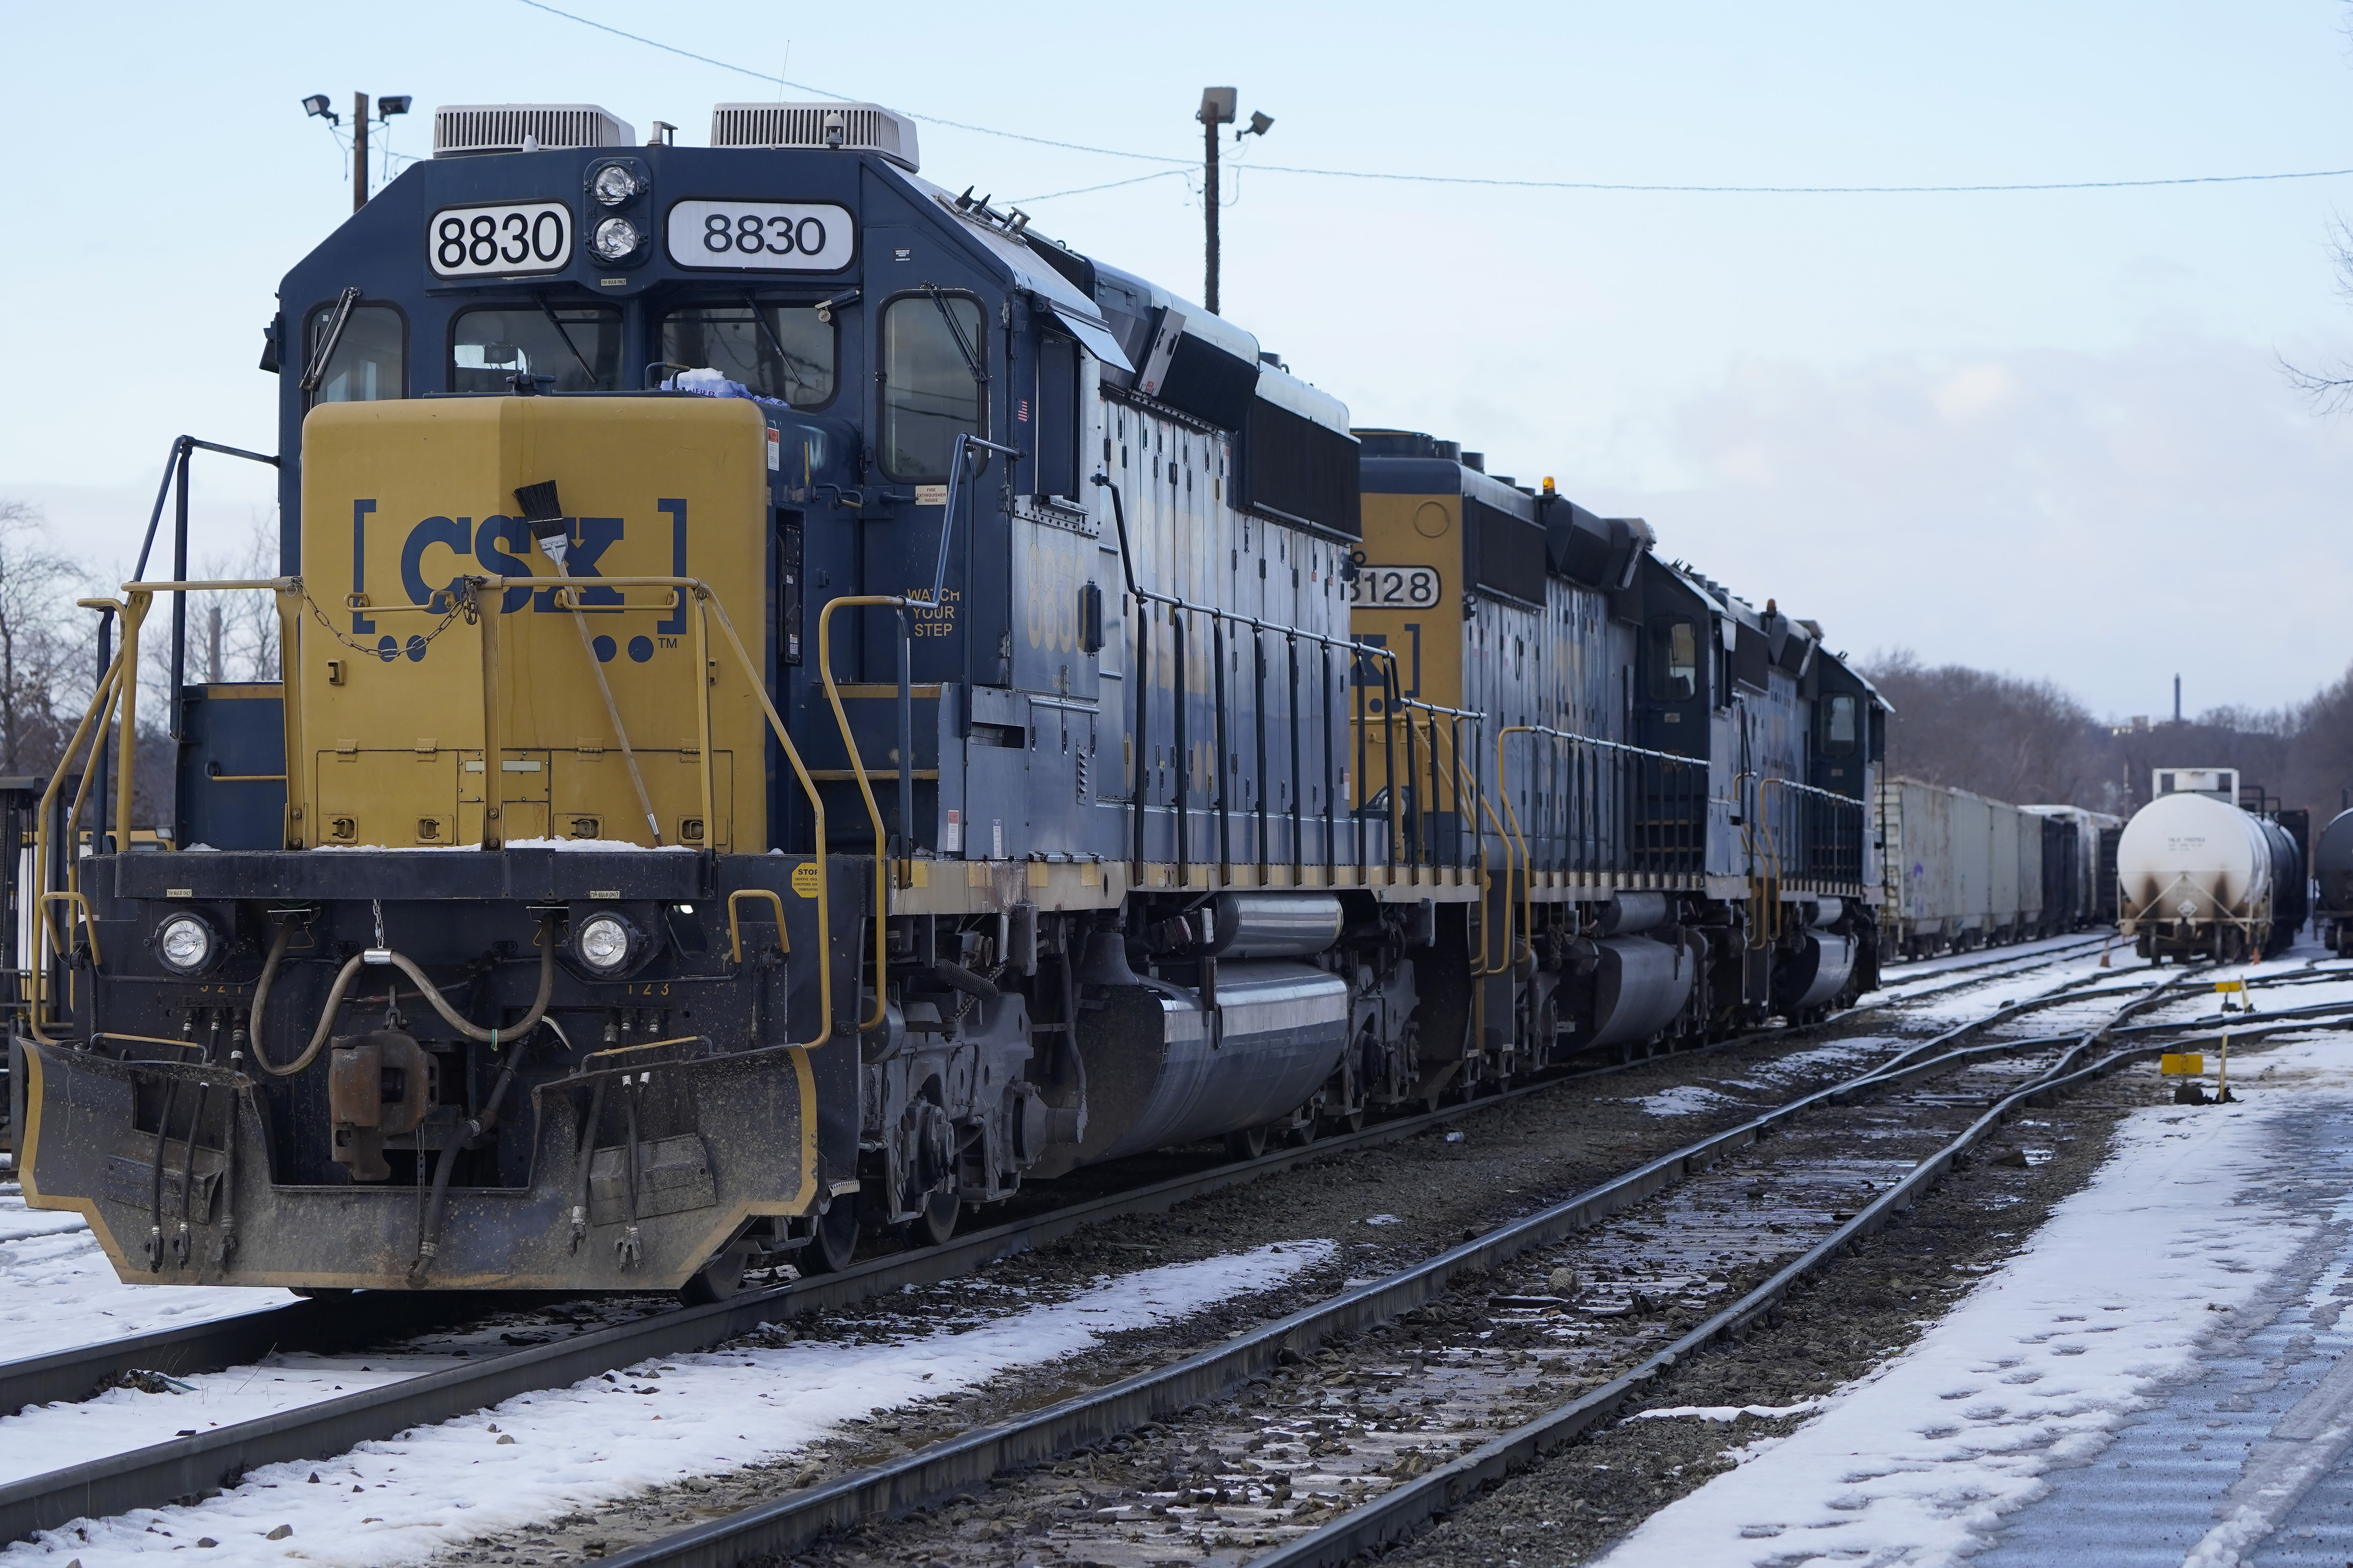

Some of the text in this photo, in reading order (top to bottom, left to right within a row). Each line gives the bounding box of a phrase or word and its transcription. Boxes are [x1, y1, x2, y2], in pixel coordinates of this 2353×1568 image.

[438, 211, 563, 268] 8830
[704, 214, 826, 255] 8830
[401, 514, 625, 615] CSX
[907, 588, 960, 601] WACH
[913, 606, 955, 619] YOUR
[915, 623, 952, 636] STEP
[658, 638, 677, 648] TM
[629, 983, 669, 995] 1 2 3
